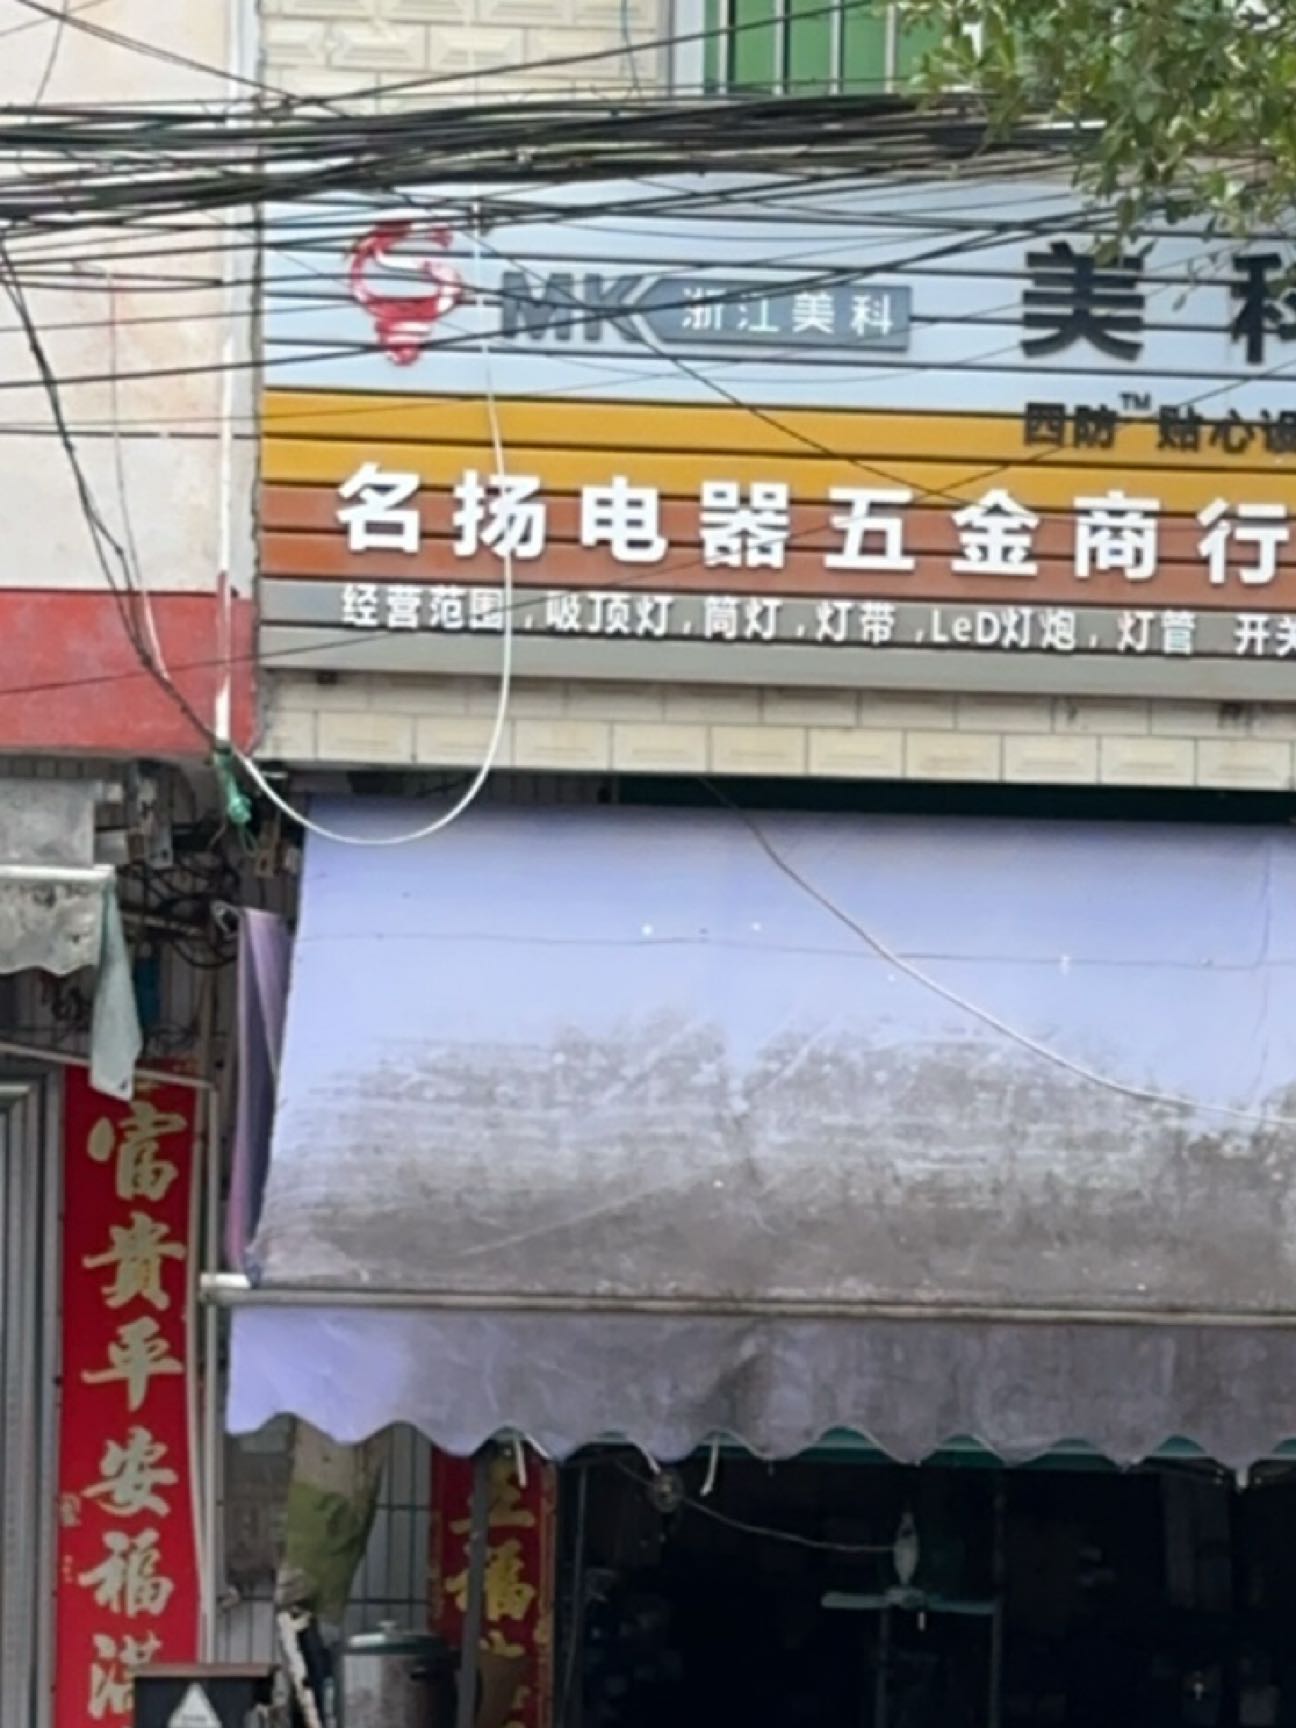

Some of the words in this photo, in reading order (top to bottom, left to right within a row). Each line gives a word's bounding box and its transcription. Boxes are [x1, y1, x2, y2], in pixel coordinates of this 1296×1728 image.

[500, 271, 642, 342] MK
[680, 286, 895, 337] 浙江美科
[337, 462, 1292, 587] 名扬电器五金商行
